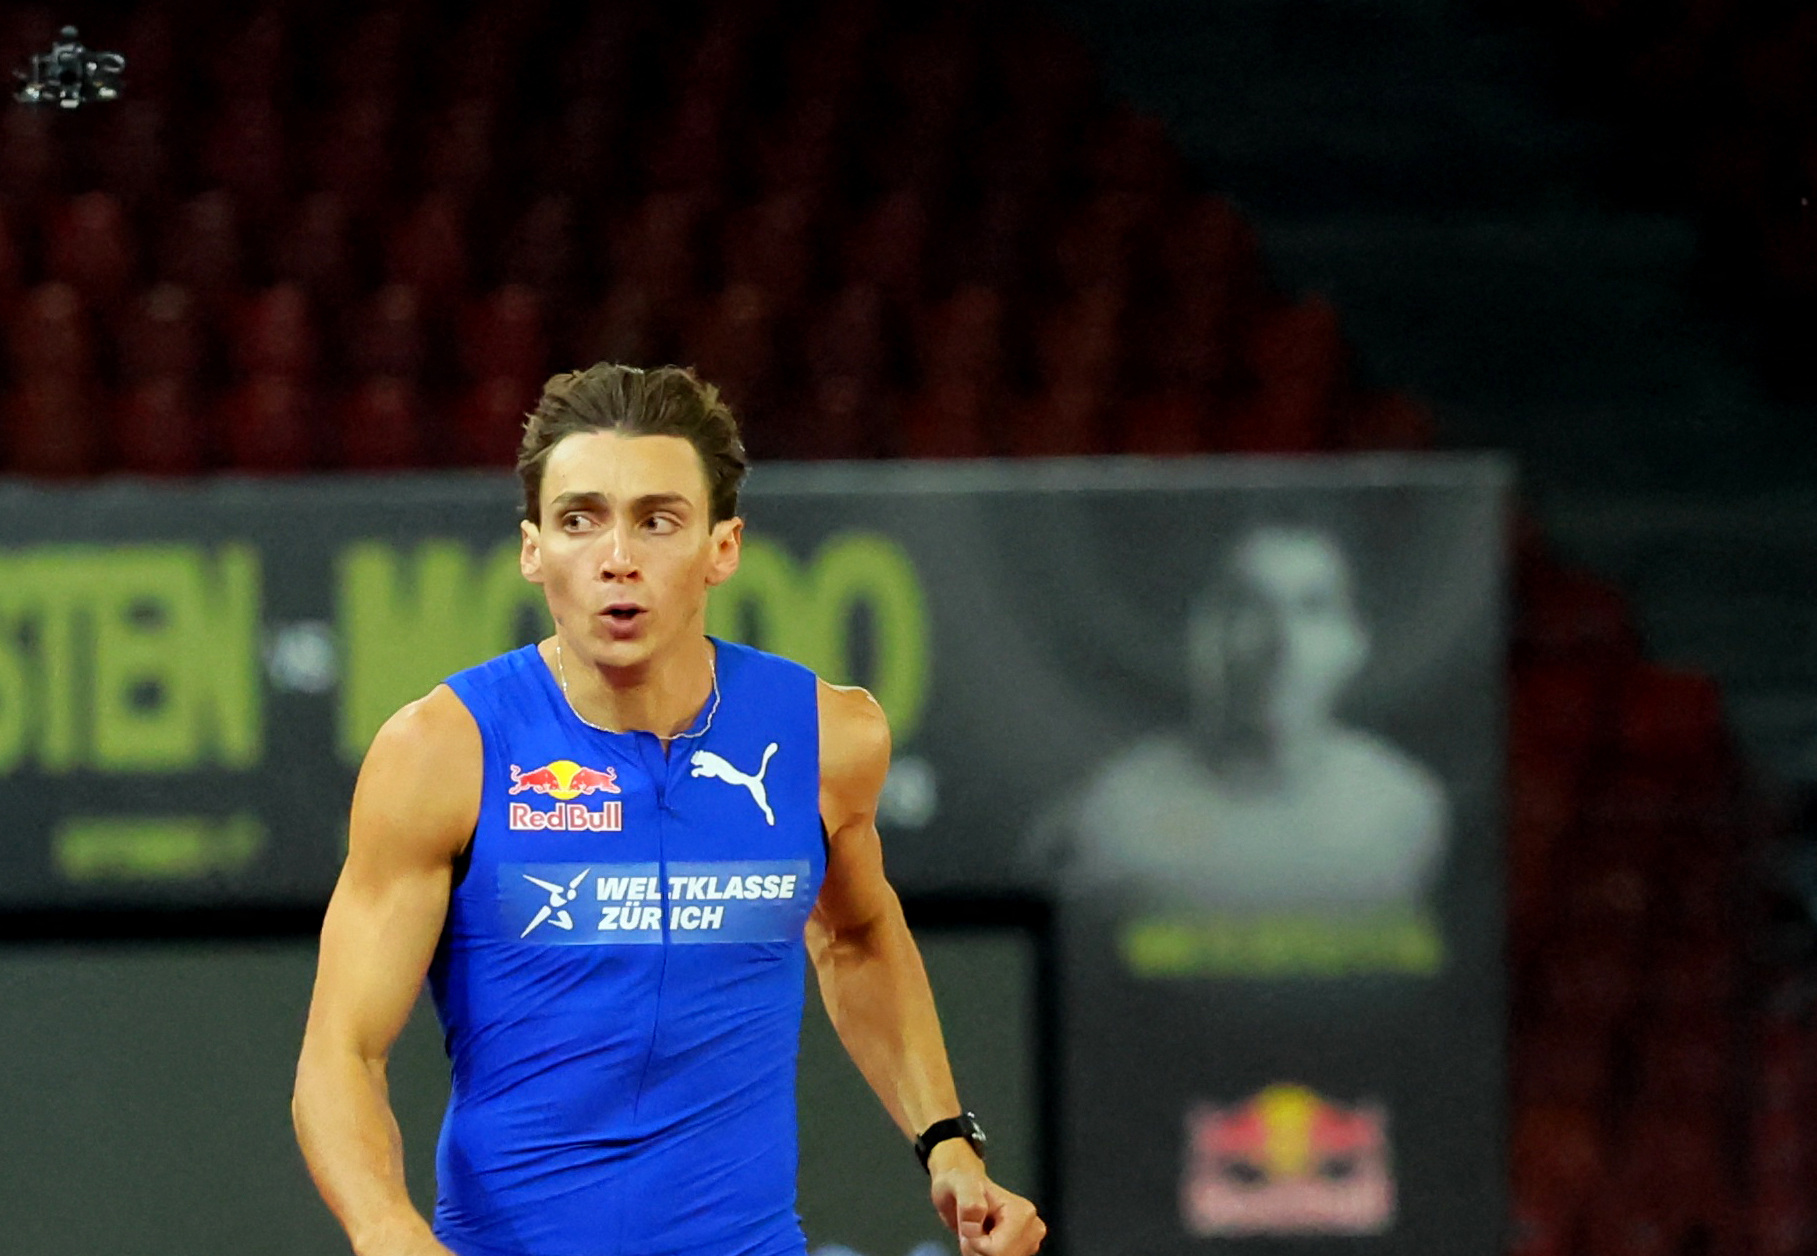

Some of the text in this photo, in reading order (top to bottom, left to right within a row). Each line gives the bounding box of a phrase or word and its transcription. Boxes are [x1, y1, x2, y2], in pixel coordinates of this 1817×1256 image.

[509, 801, 622, 831] Red Bull
[596, 875, 796, 901] WELTKLASSE
[597, 902, 724, 930] ZÜRICH
